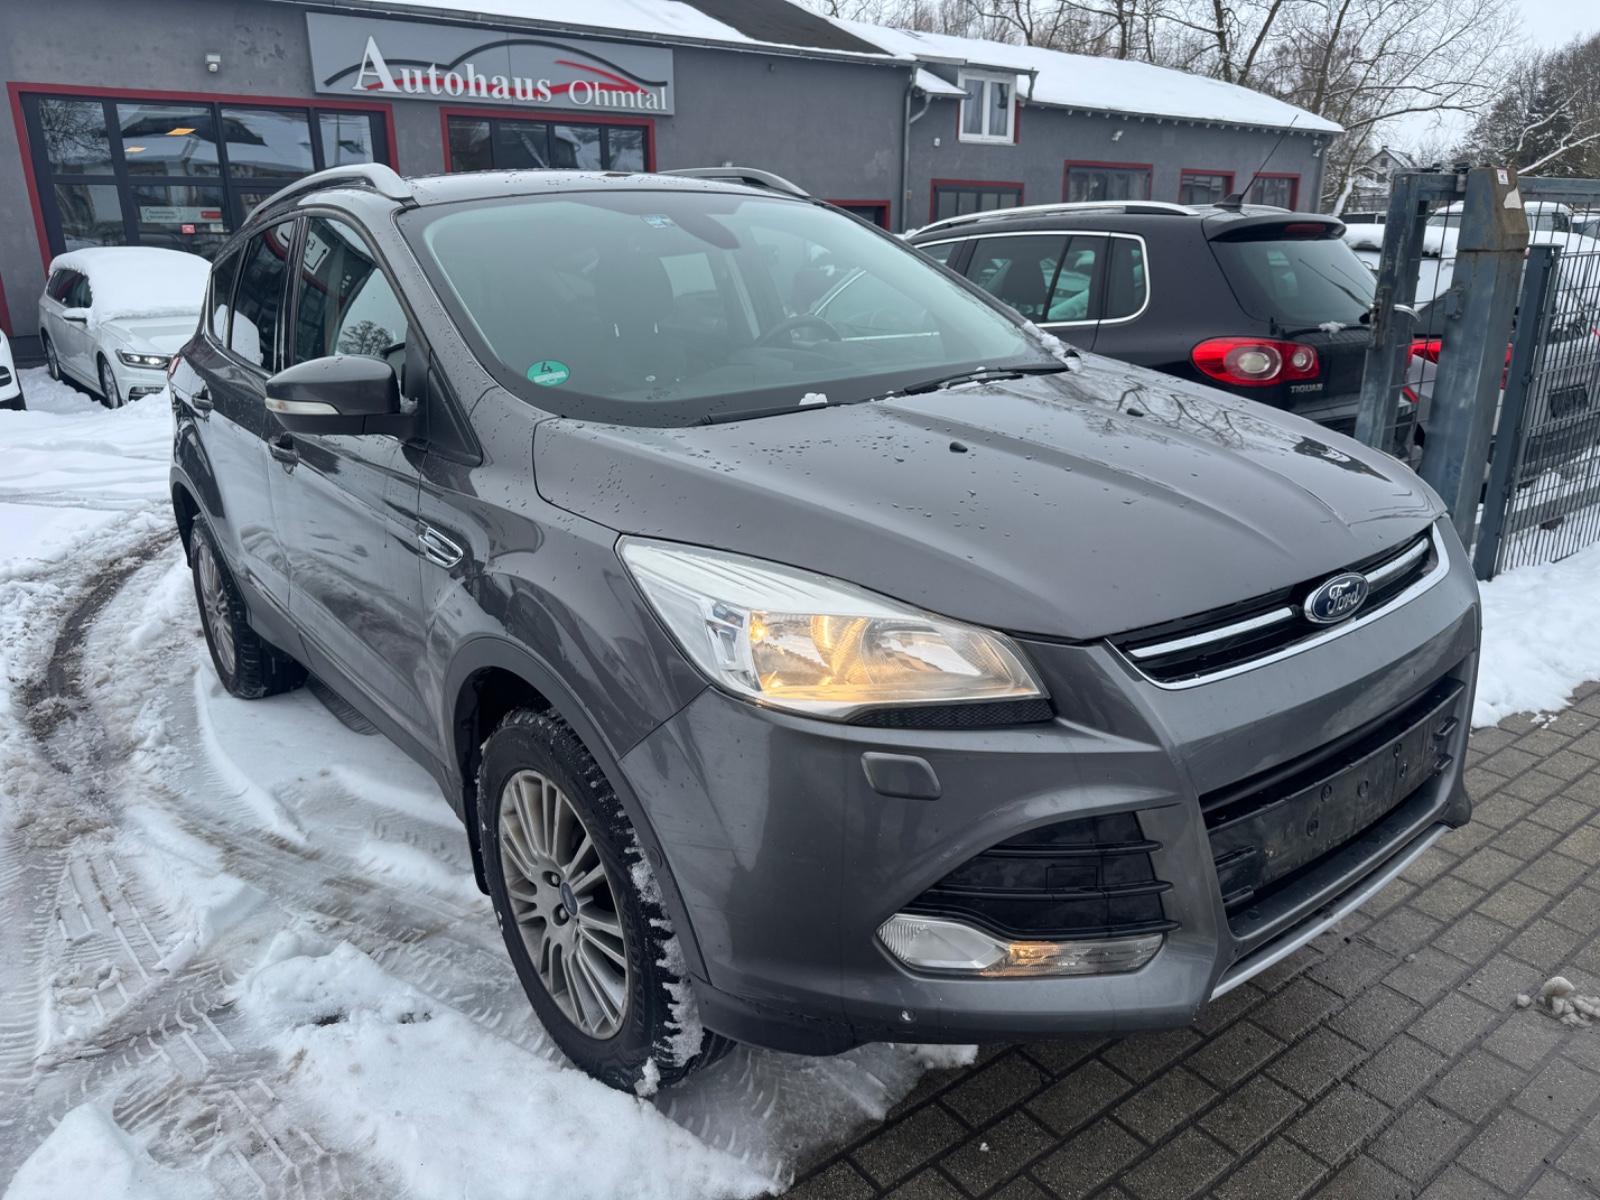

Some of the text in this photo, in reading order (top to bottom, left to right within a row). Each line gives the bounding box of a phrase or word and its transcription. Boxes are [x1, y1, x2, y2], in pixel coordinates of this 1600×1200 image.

[352, 35, 667, 110] Autohaus Ohmtal
[540, 361, 553, 374] 4
[1327, 581, 1360, 614] Ford
